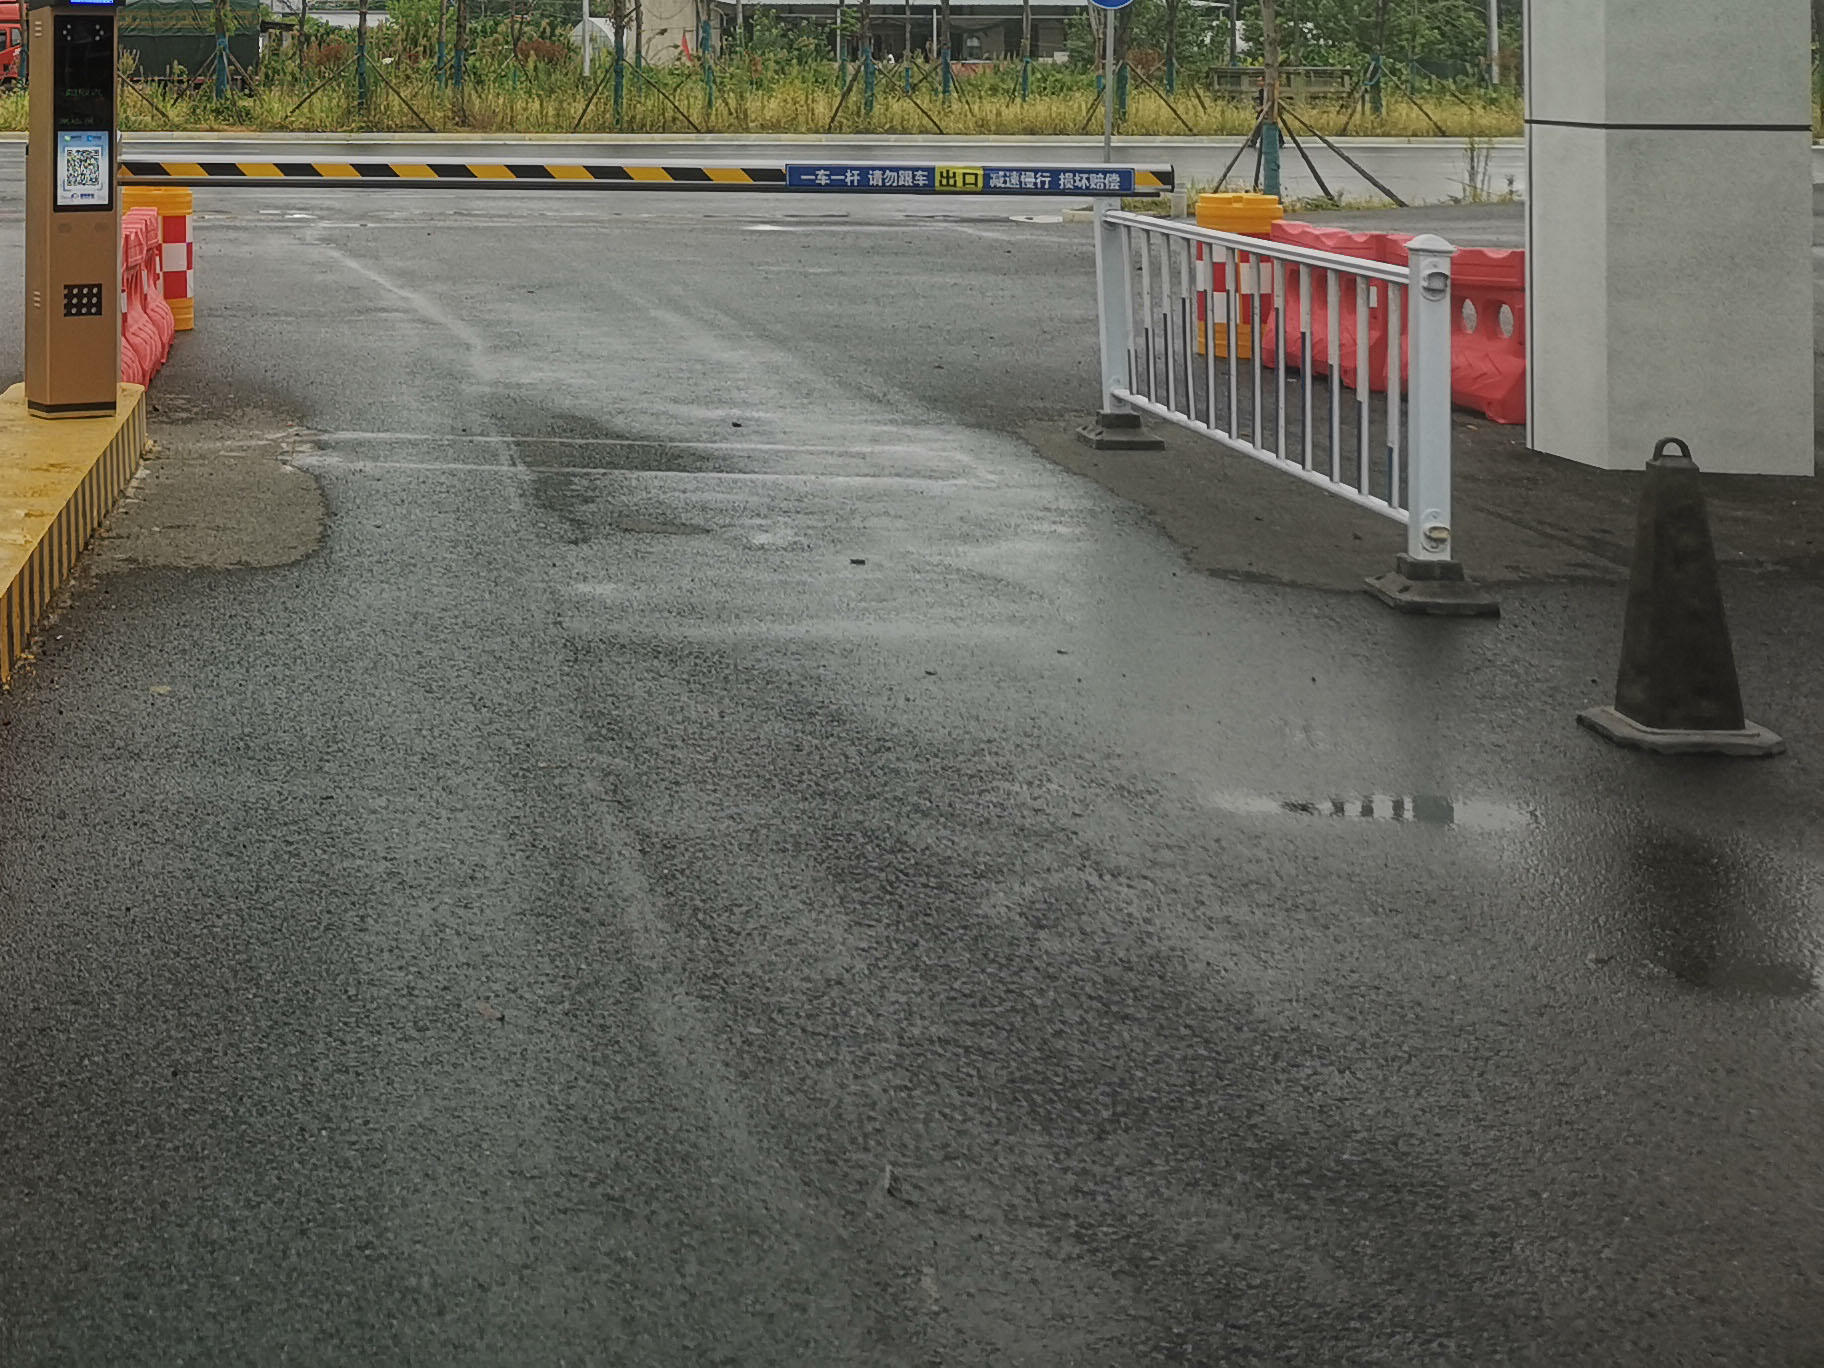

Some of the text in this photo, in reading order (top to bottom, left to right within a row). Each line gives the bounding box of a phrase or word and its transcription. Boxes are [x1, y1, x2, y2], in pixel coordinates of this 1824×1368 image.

[800, 169, 1121, 190] 一车一杆 请勿跟车 出口 减速慢行 损坏赔偿
